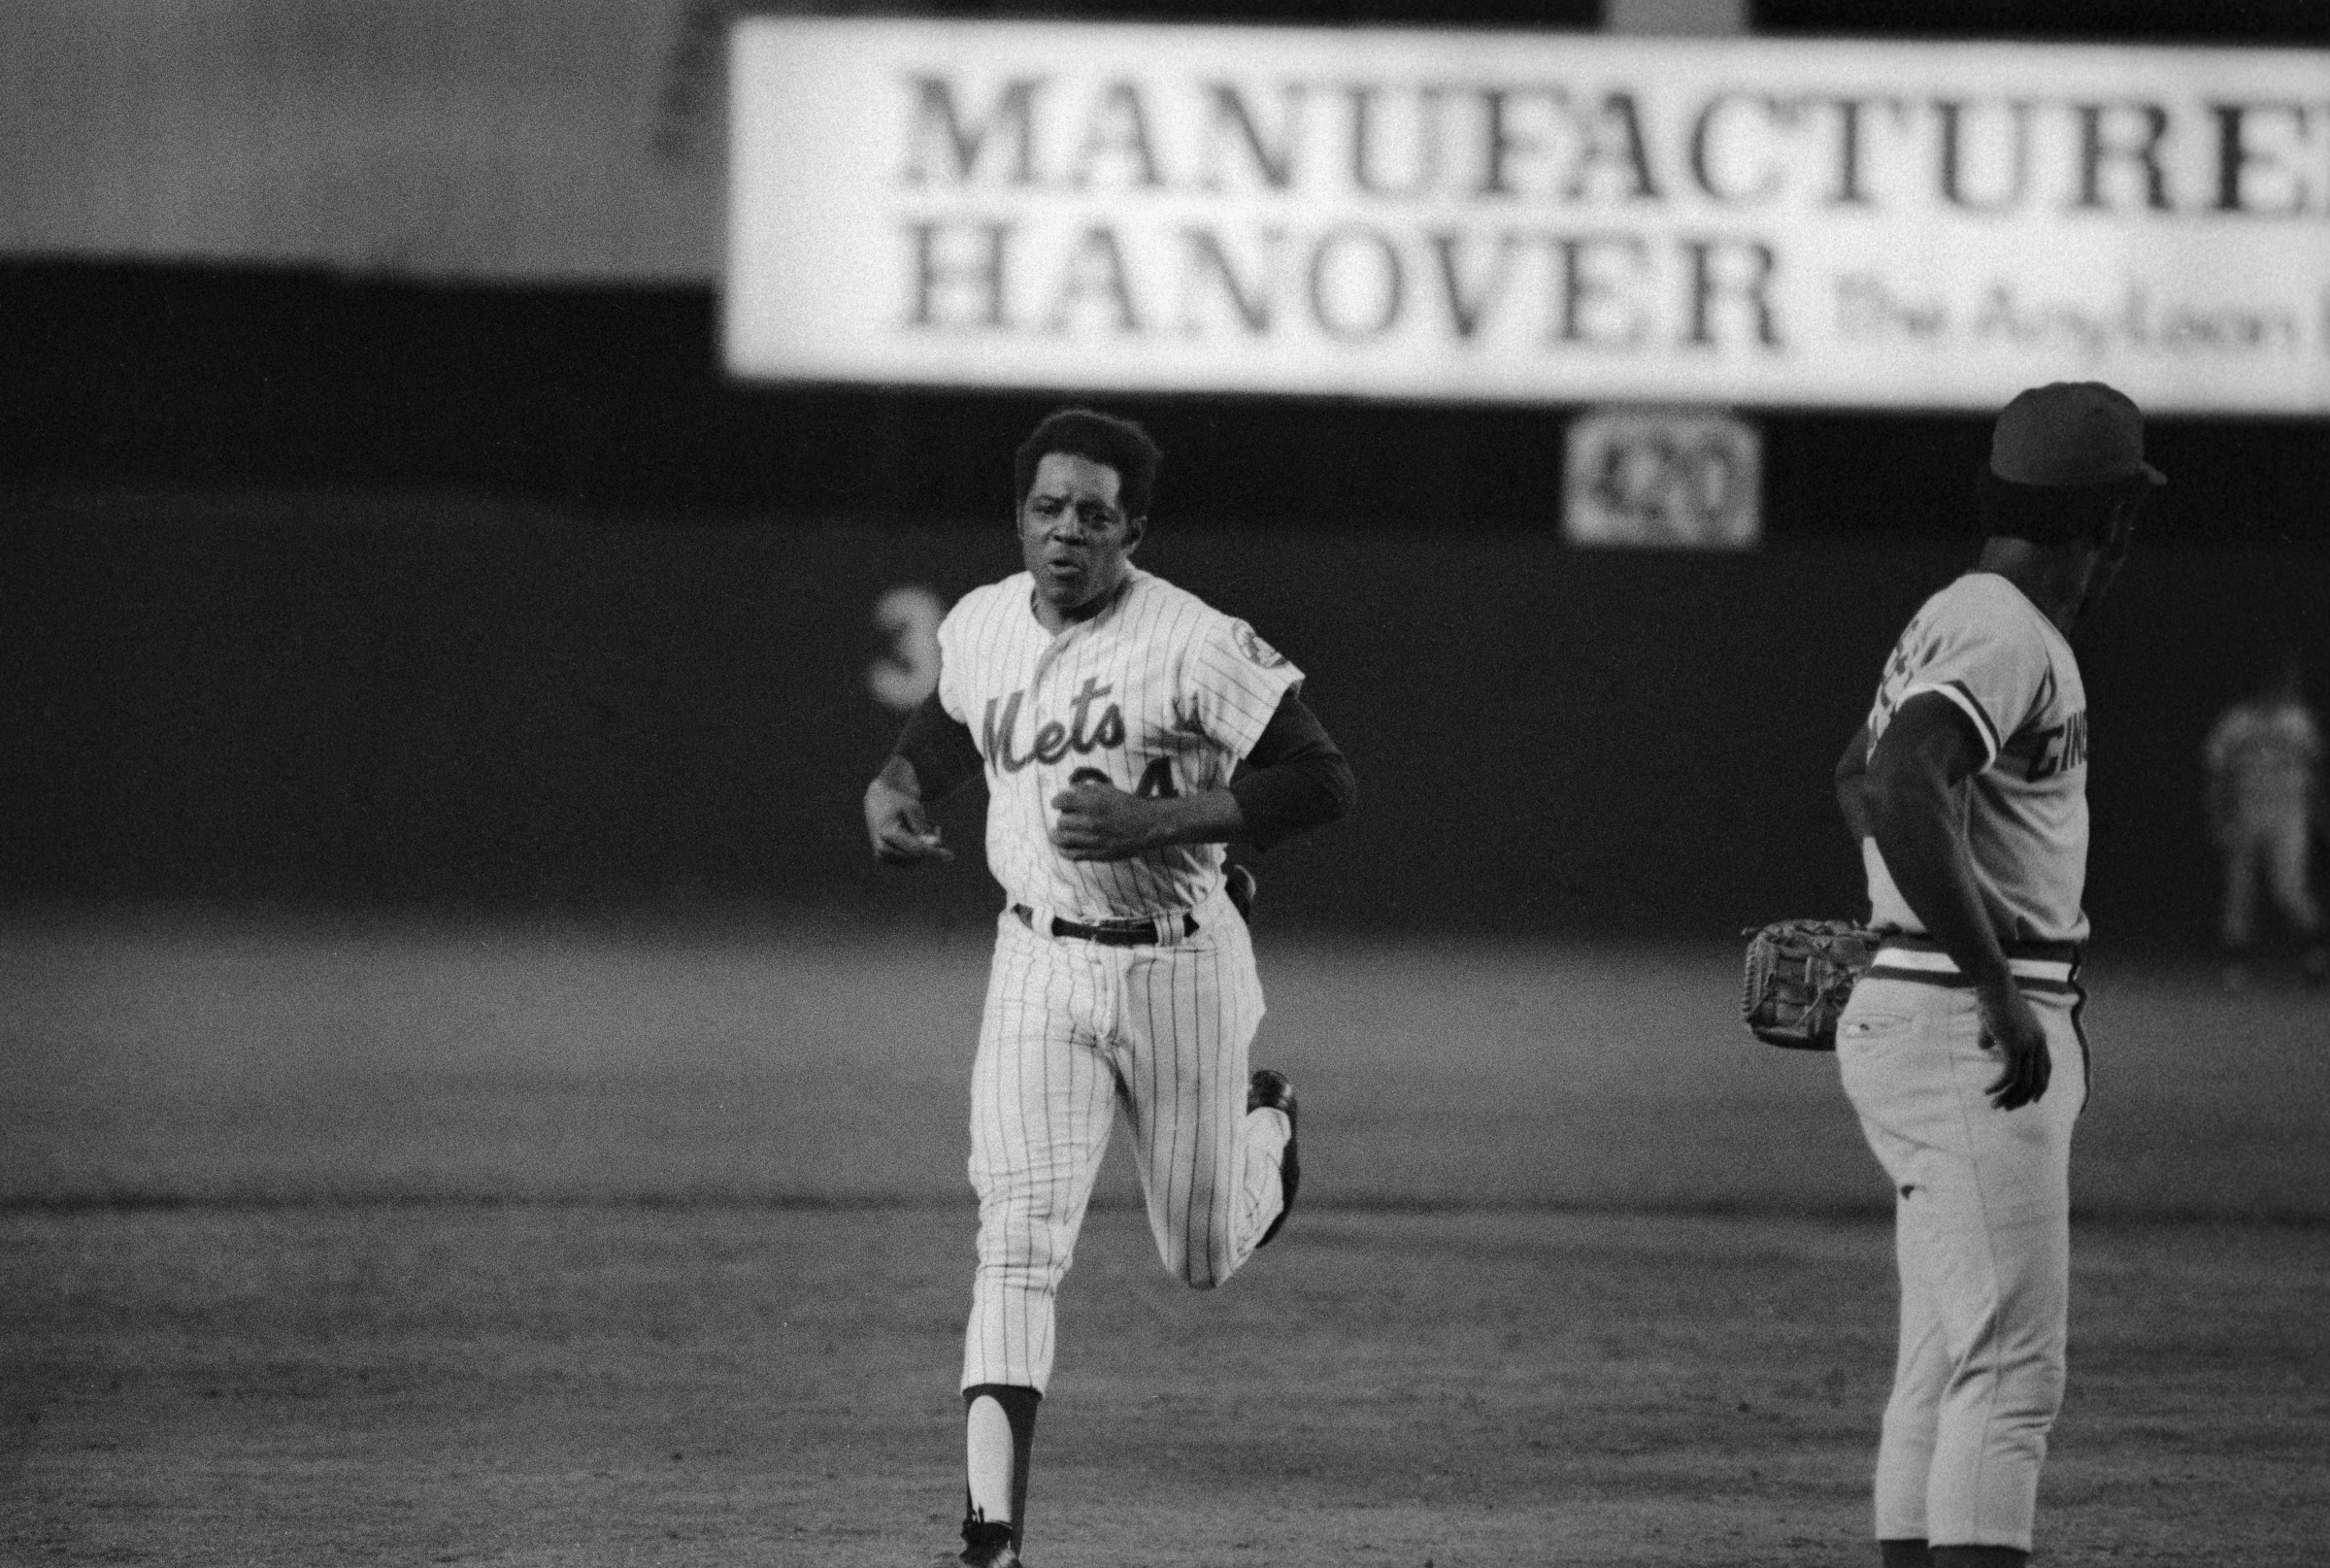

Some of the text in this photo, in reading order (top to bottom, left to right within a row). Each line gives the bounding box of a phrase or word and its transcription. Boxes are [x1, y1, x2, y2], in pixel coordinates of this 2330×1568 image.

[901, 68, 2330, 216] MANUFACTURE
[903, 214, 1781, 350] HANOVER
[982, 677, 1126, 773] Mets
[2019, 710, 2086, 783] CIN
